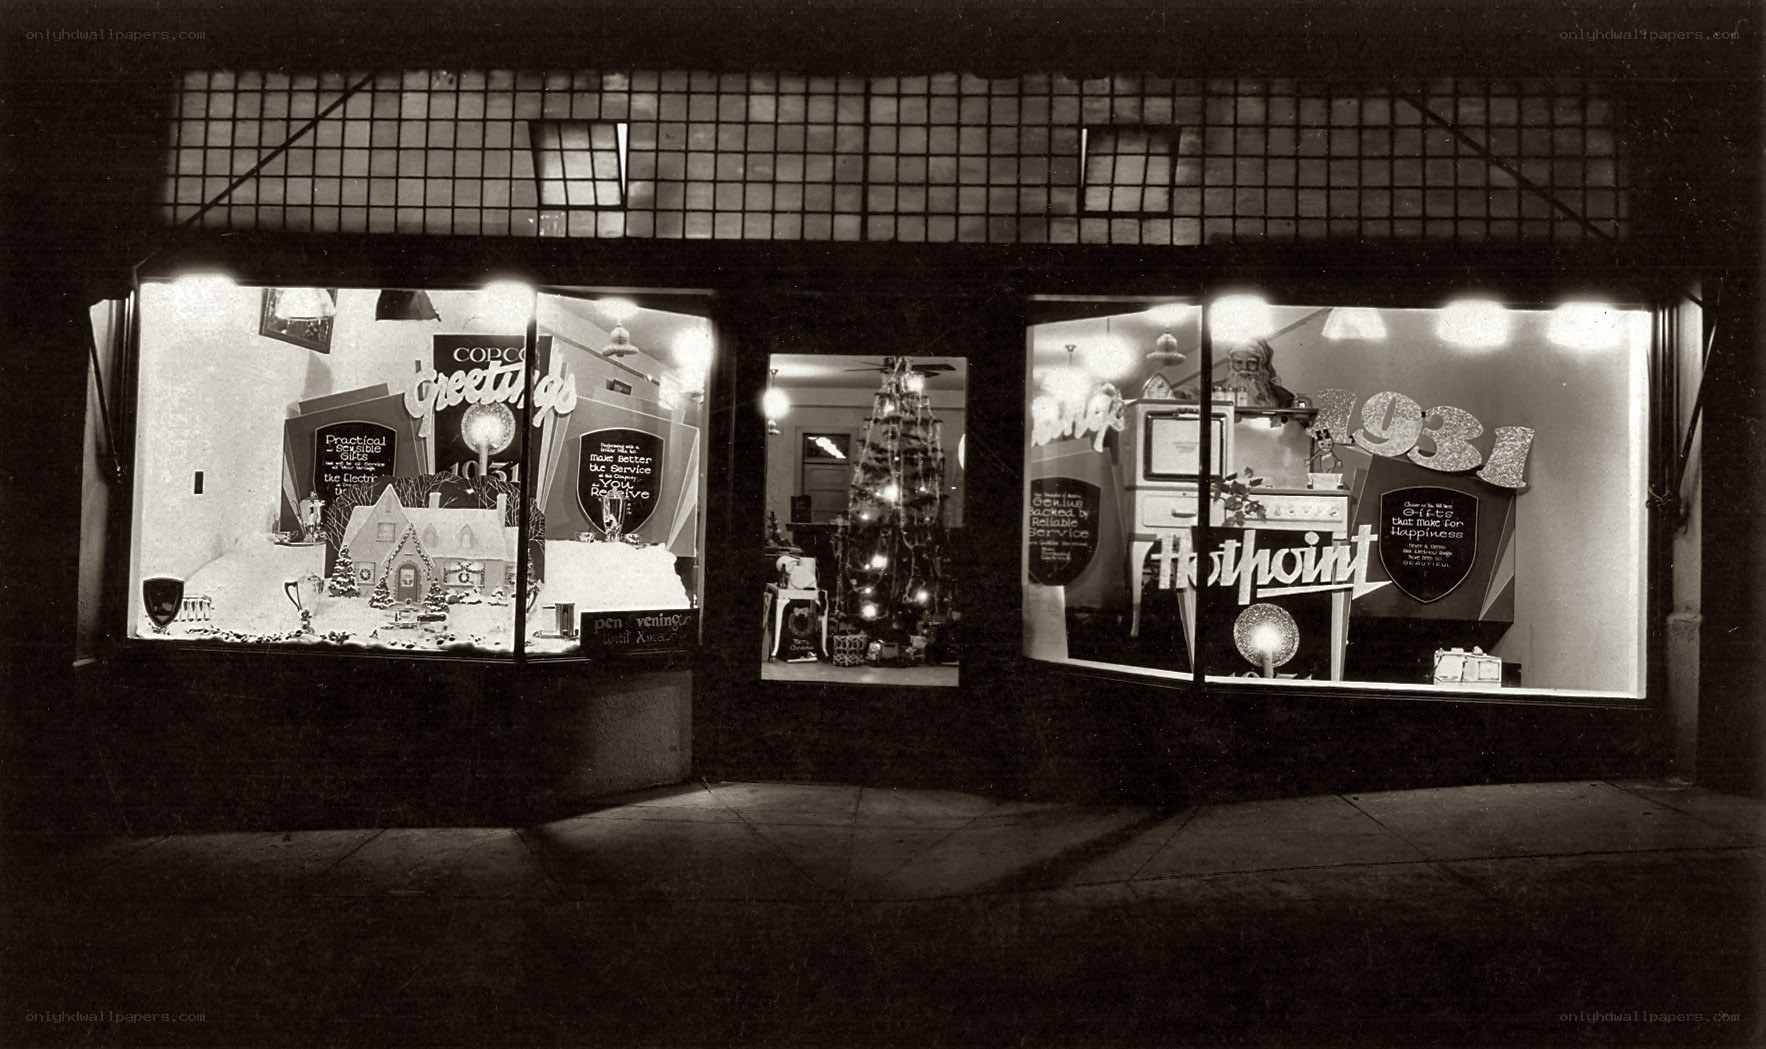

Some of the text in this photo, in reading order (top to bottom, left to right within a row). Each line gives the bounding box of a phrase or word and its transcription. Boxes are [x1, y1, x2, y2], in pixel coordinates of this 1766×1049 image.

[326, 434, 386, 446] Practical
[1305, 388, 1535, 488] 1931
[335, 444, 381, 453] Sensible
[340, 452, 368, 461] Gifts
[617, 455, 652, 464] Better
[589, 463, 651, 474] the Service
[1033, 497, 1083, 508] Genius
[1079, 508, 1089, 520] by
[1403, 508, 1454, 518] Gifts
[1032, 517, 1078, 527] Reliable
[1392, 517, 1414, 526] that
[1444, 519, 1464, 528] for
[1029, 528, 1089, 539] Service
[1390, 526, 1464, 541] Happiness
[1151, 524, 1392, 605] Hotpoint
[594, 616, 623, 633] pen
